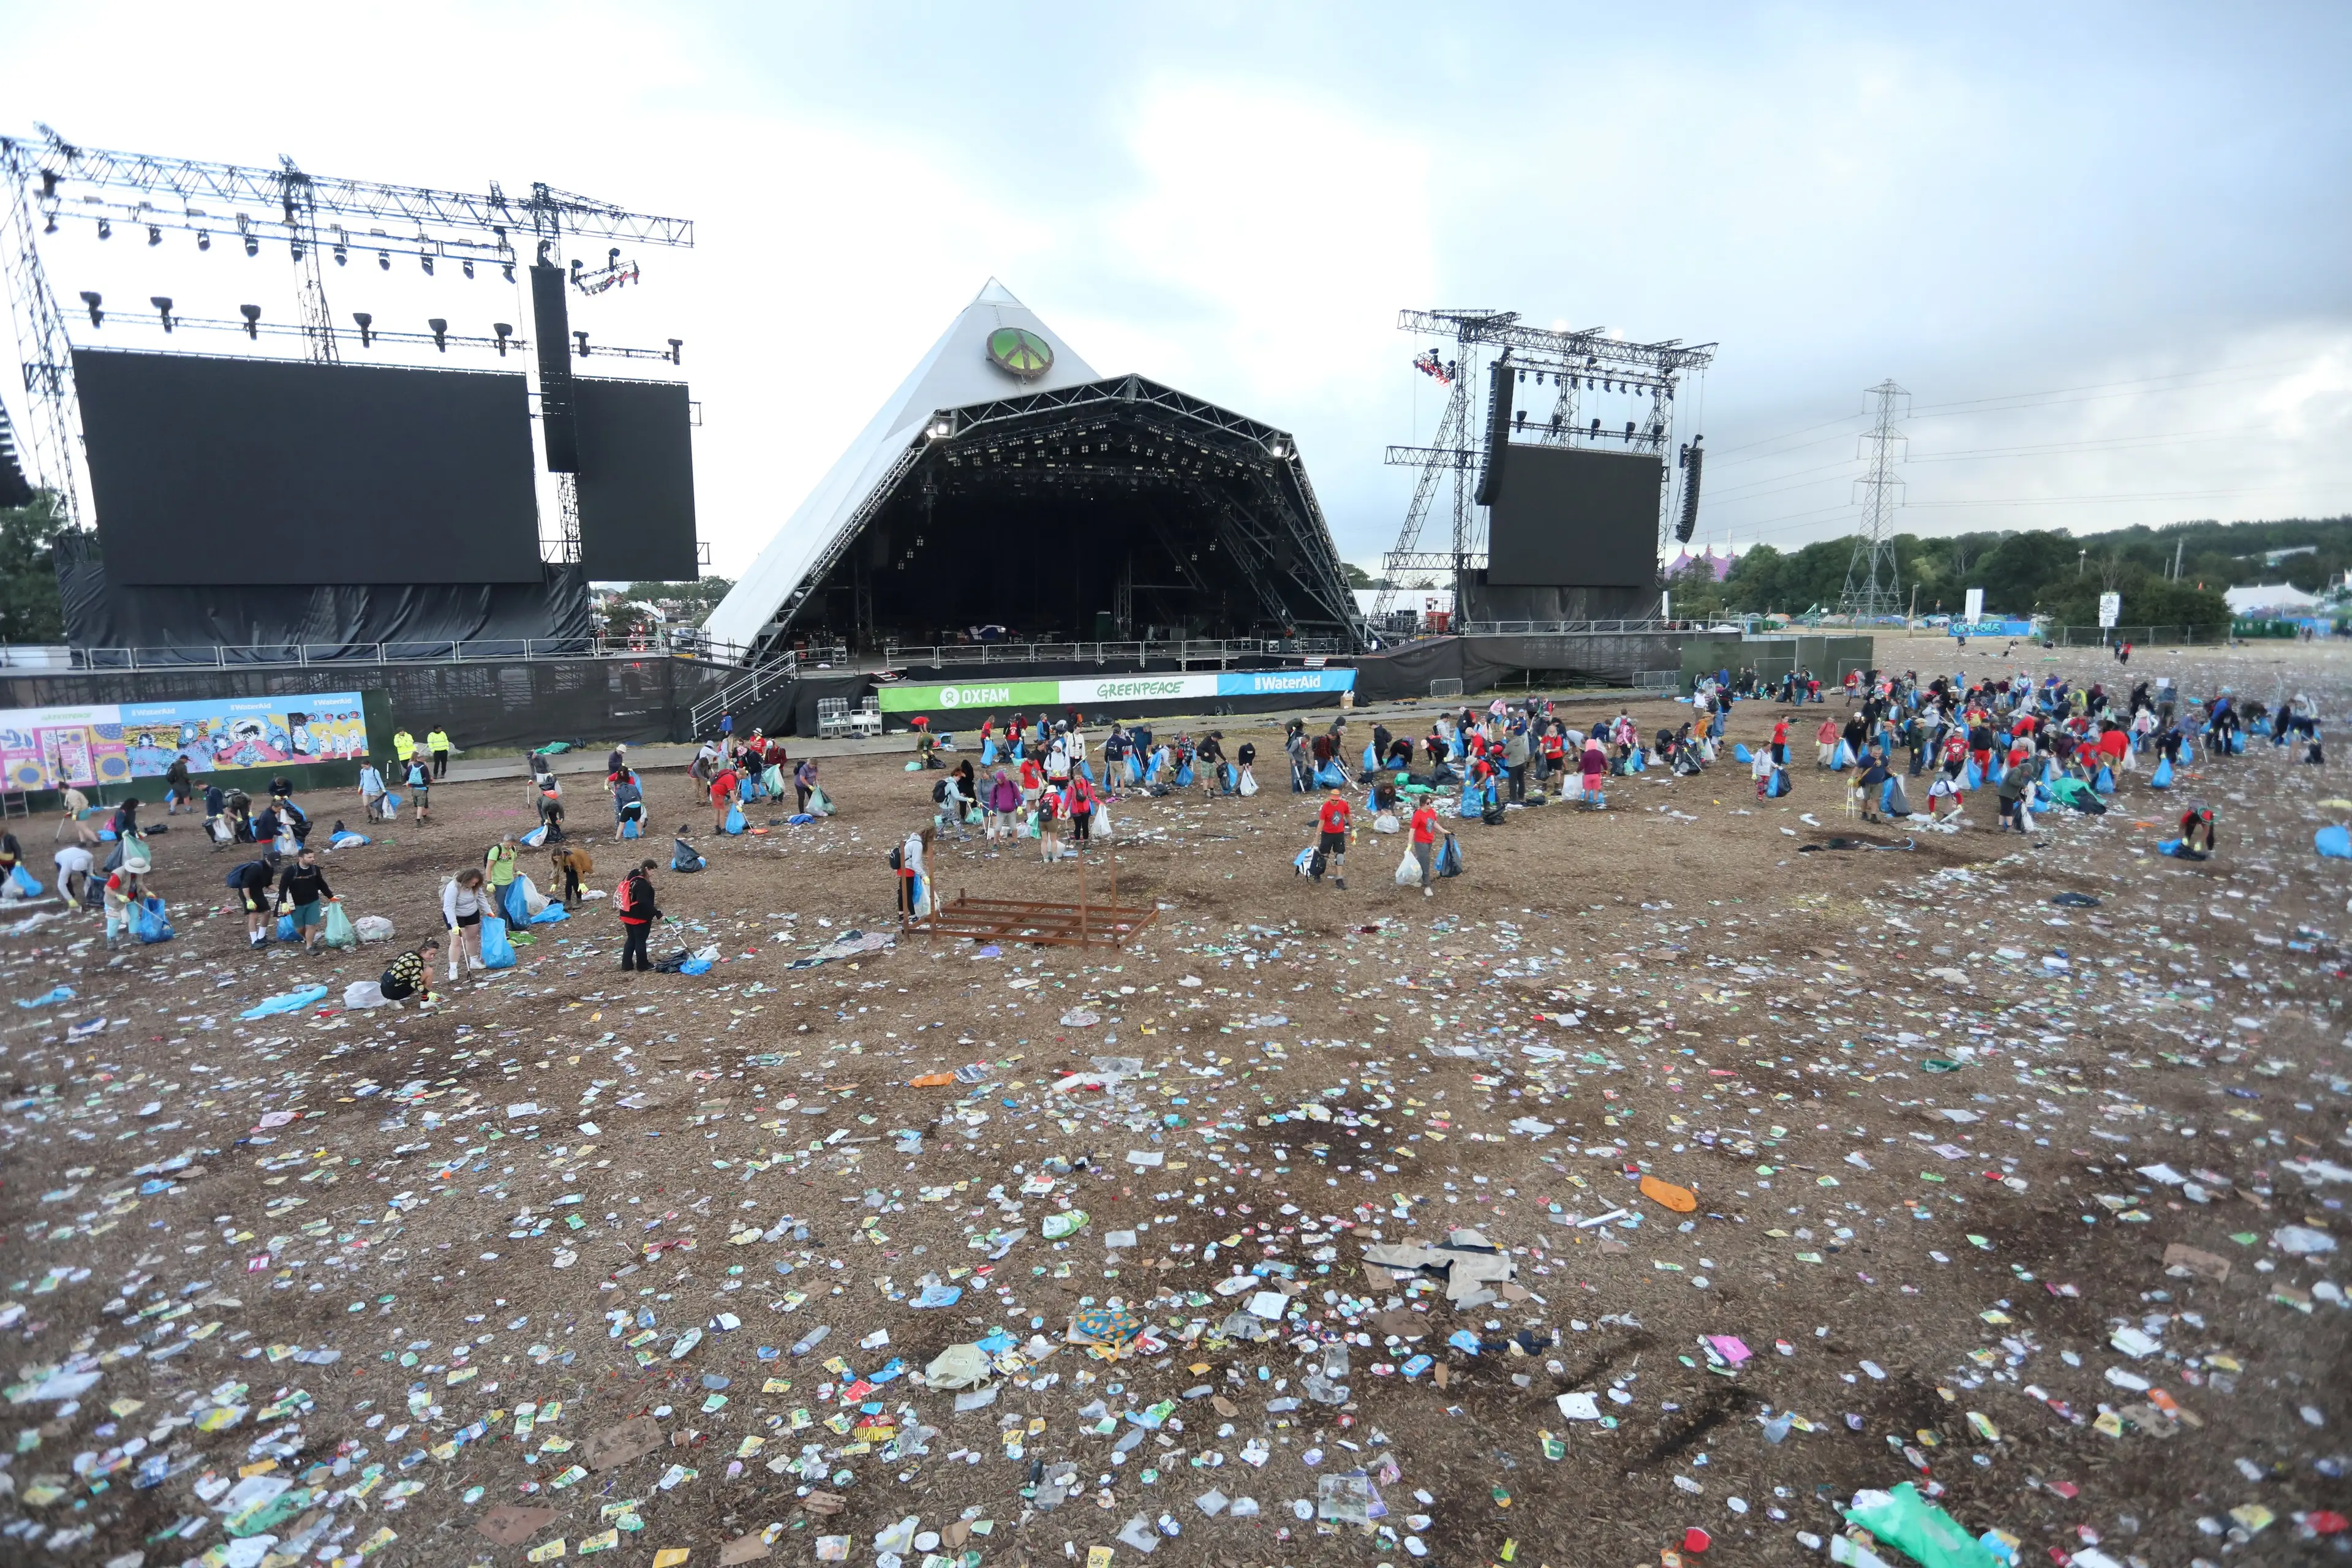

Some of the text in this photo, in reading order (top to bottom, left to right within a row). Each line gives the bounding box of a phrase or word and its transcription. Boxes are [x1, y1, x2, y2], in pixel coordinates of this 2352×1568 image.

[1096, 681, 1185, 699] GREENPEACE
[1262, 674, 1321, 690] WaterAid
[962, 688, 1009, 704] OXFAM
